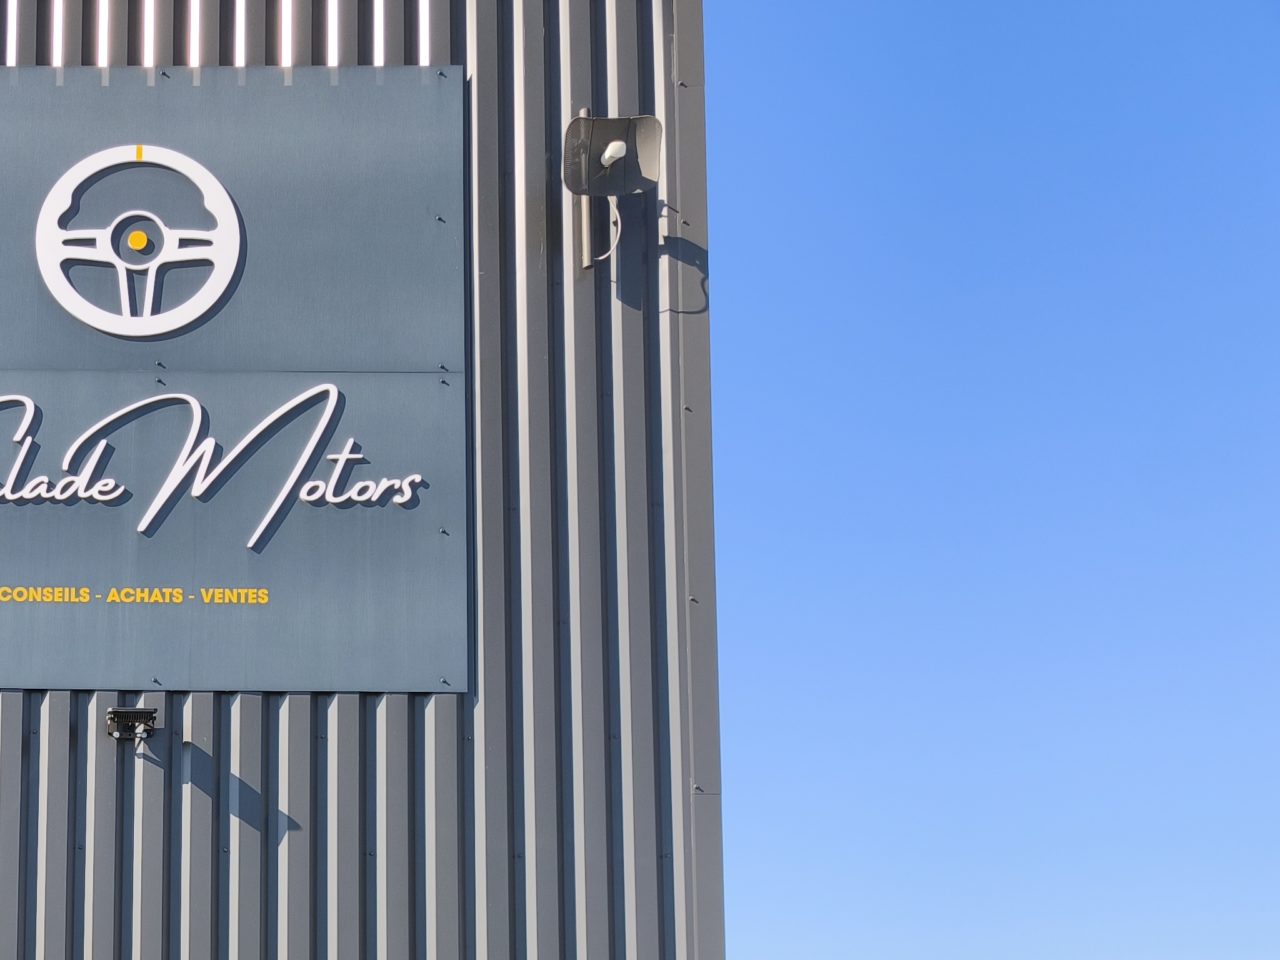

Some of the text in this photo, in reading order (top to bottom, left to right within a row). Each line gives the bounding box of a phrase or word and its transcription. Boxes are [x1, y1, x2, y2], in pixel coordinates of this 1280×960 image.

[63, 383, 422, 549] Motors
[106, 586, 184, 605] ACHATS
[199, 587, 269, 605] VENTES
